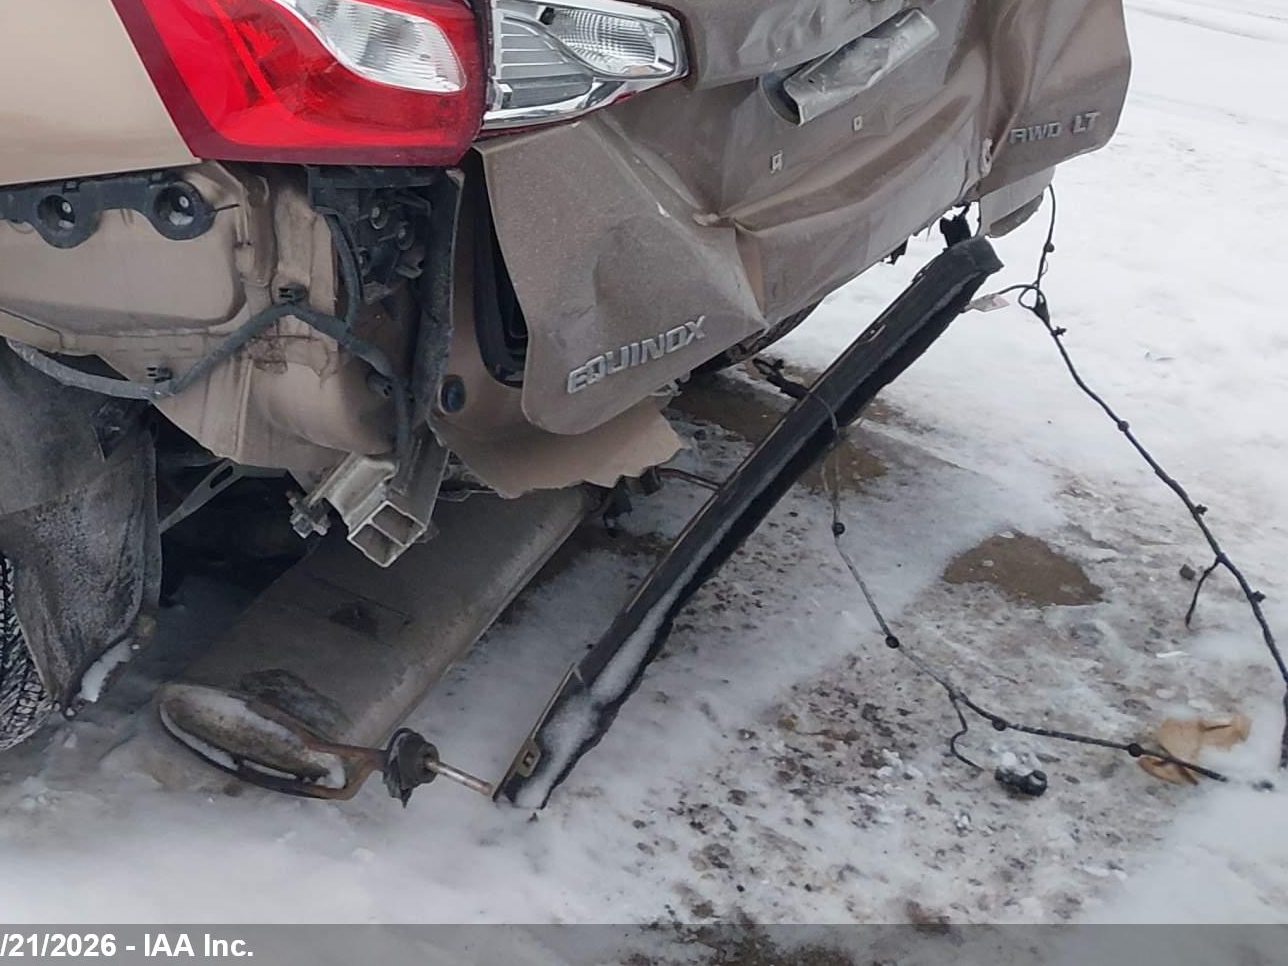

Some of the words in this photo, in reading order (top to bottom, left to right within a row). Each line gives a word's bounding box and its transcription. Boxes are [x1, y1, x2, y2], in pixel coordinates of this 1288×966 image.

[1010, 122, 1062, 144] AWD
[1073, 112, 1101, 133] LT
[567, 315, 706, 394] EQUINOX
